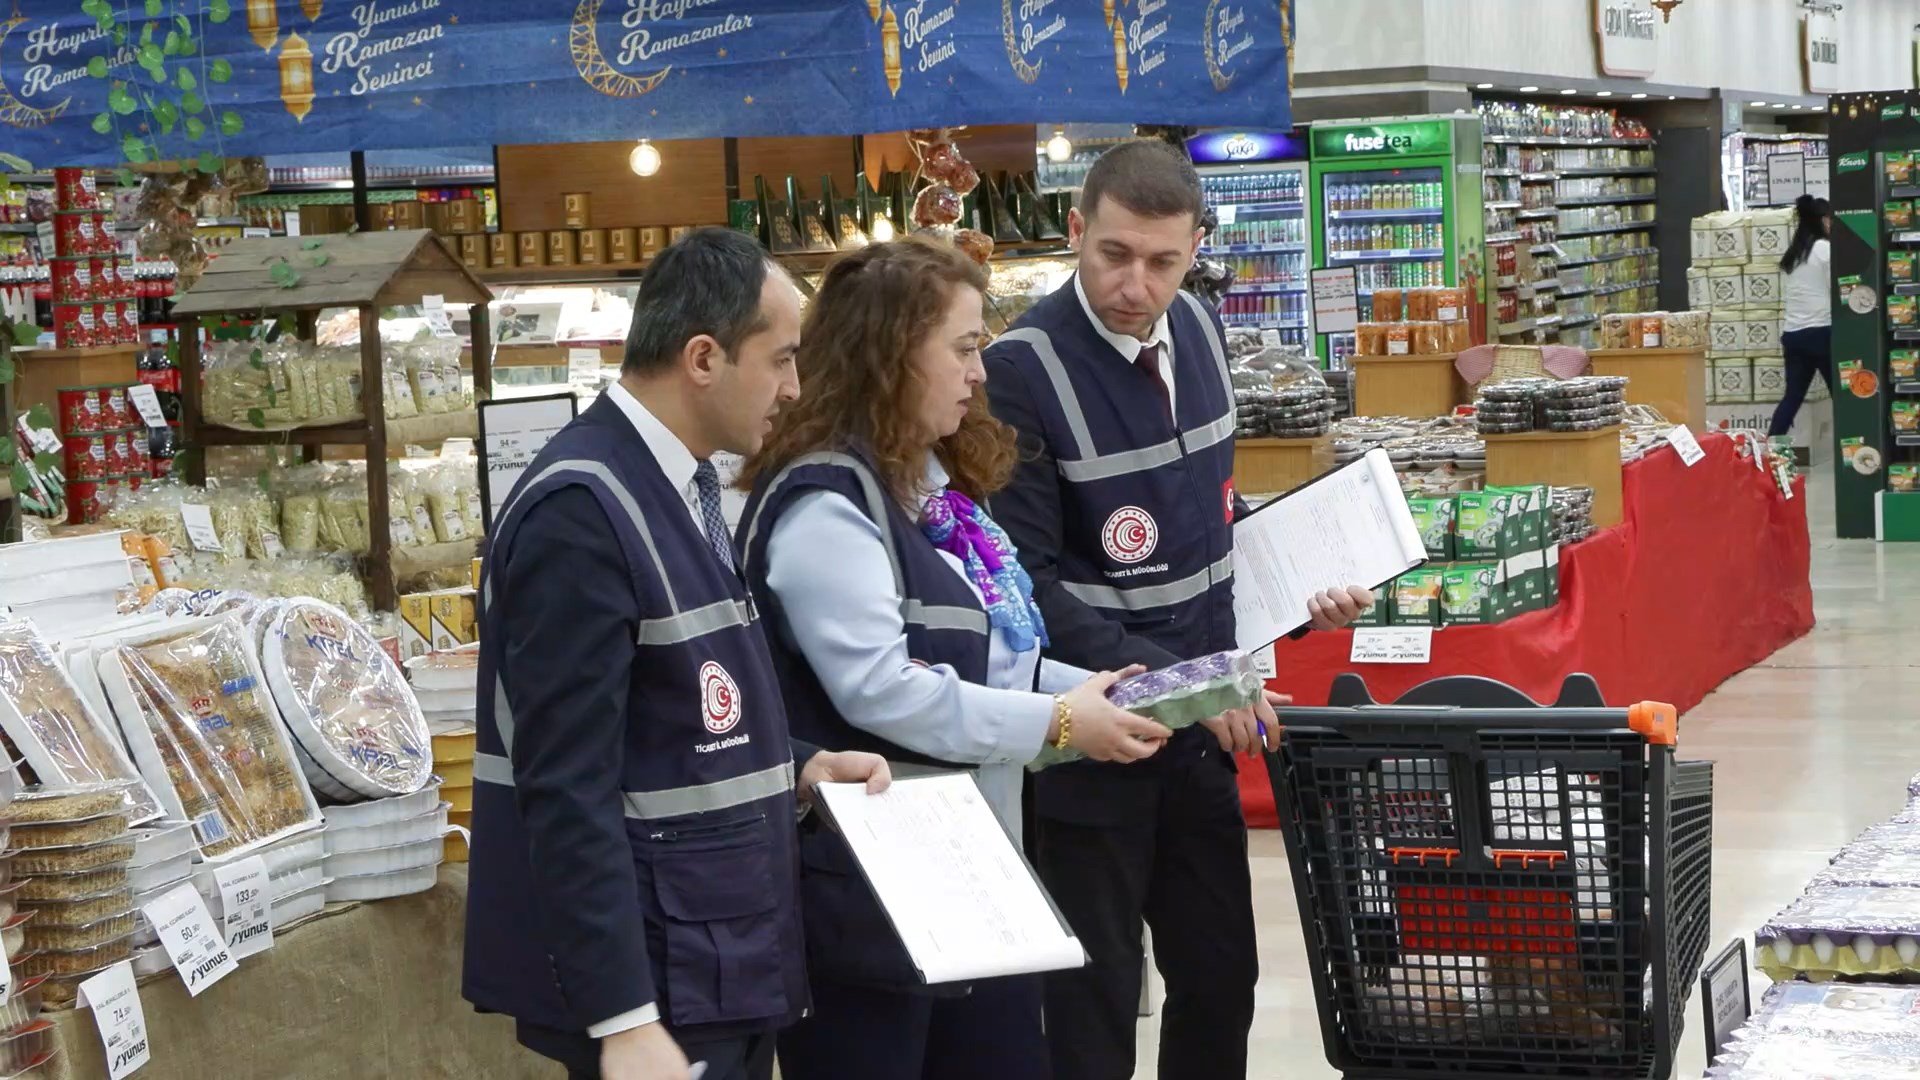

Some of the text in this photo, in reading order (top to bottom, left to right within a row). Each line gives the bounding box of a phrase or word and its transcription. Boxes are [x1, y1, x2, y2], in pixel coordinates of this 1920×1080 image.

[617, 13, 753, 66] Ramazanlar
[903, 5, 955, 49] Ramazan
[1129, 20, 1168, 55] Ramazan
[321, 23, 445, 74] Ramazan
[918, 32, 956, 72] Sevinci
[1138, 44, 1165, 76] Sevinci
[20, 47, 142, 97] Ramanlar
[350, 52, 435, 96] Sevinci
[239, 921, 269, 944] yunus
[196, 951, 228, 980] yunus
[121, 1039, 147, 1066] yunus
